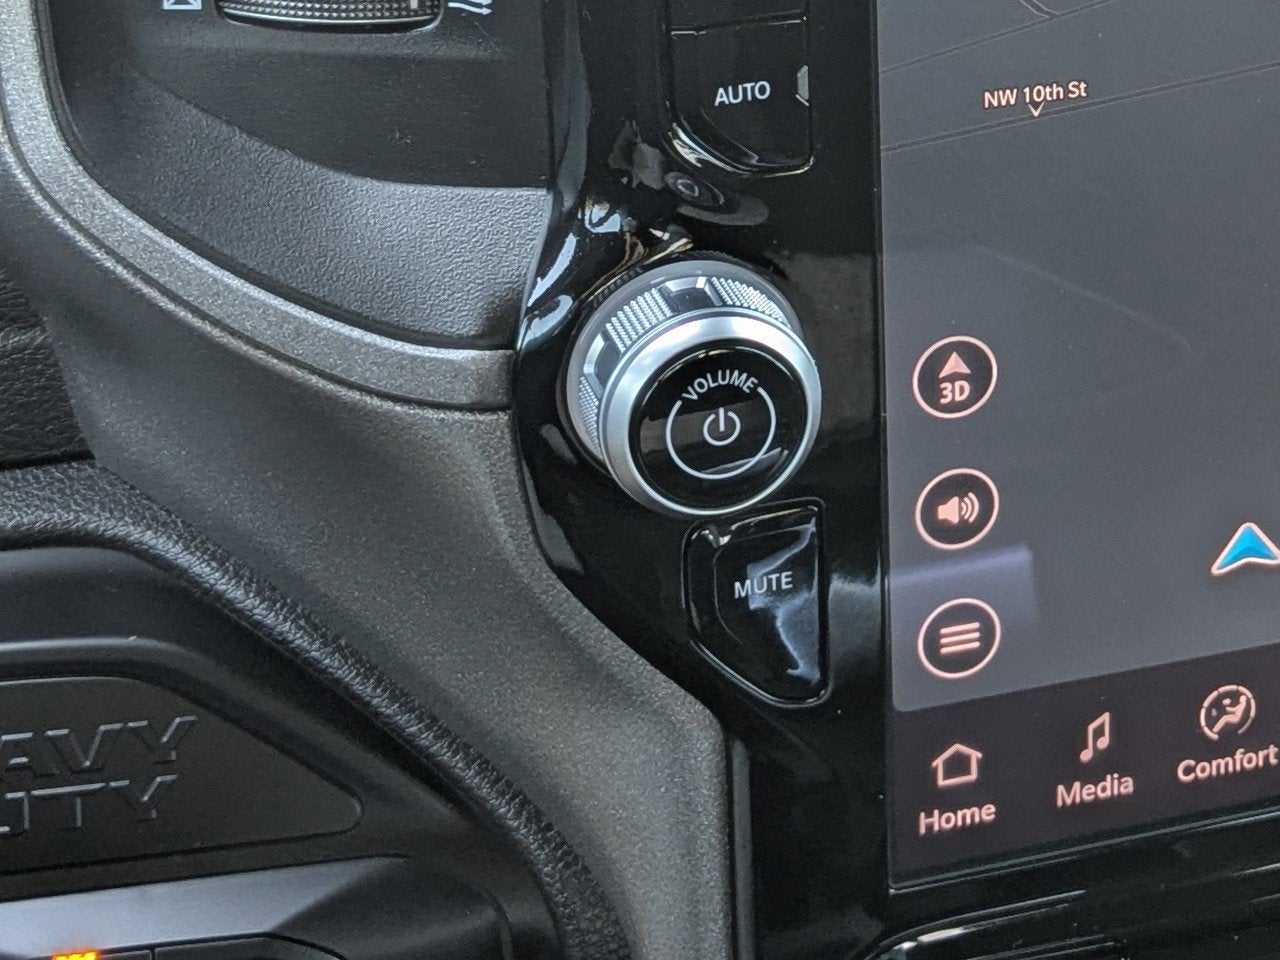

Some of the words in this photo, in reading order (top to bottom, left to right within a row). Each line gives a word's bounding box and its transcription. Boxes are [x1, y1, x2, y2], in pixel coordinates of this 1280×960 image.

[714, 80, 771, 107] AUTO
[983, 88, 1018, 109] NW
[1022, 83, 1065, 105] 10th
[1067, 81, 1088, 100] St
[682, 369, 759, 401] VOLUME
[939, 380, 971, 404] 3D
[734, 571, 794, 598] MUTE
[1176, 744, 1279, 784] Comfort
[1056, 773, 1135, 808] Media
[918, 801, 996, 836] Home
